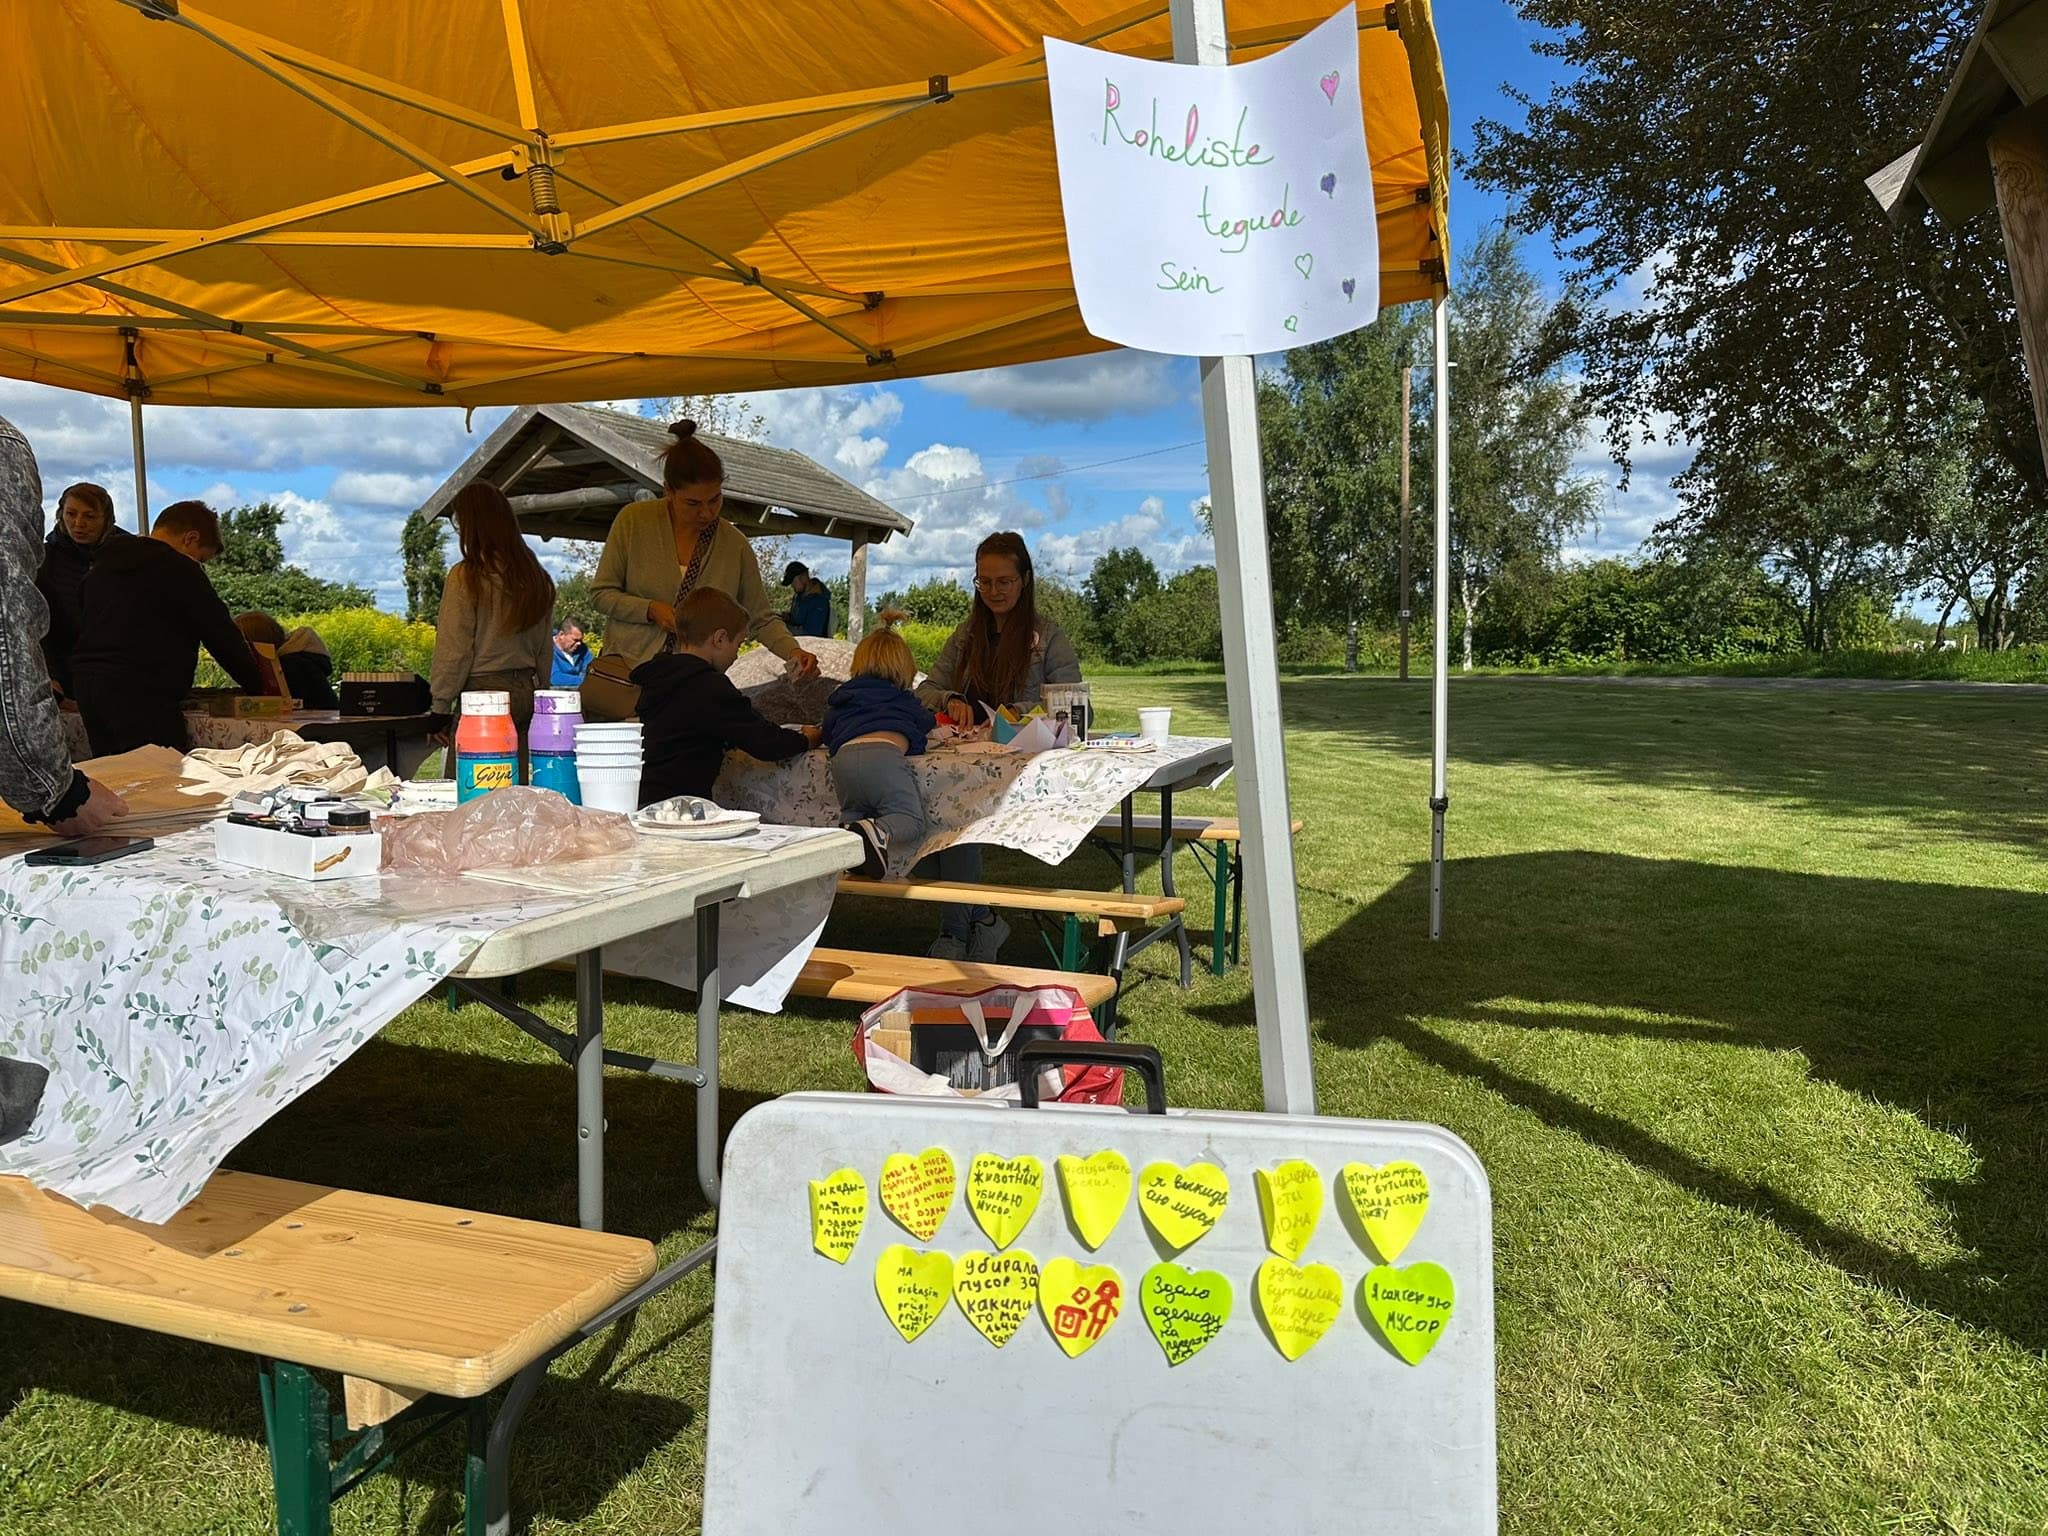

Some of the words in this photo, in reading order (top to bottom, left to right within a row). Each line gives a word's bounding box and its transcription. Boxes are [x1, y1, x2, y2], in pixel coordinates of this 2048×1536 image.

[1103, 77, 1274, 167] Roheliste
[1197, 182, 1304, 253] tegude
[1157, 261, 1223, 294] Sein
[465, 766, 518, 791] Goya
